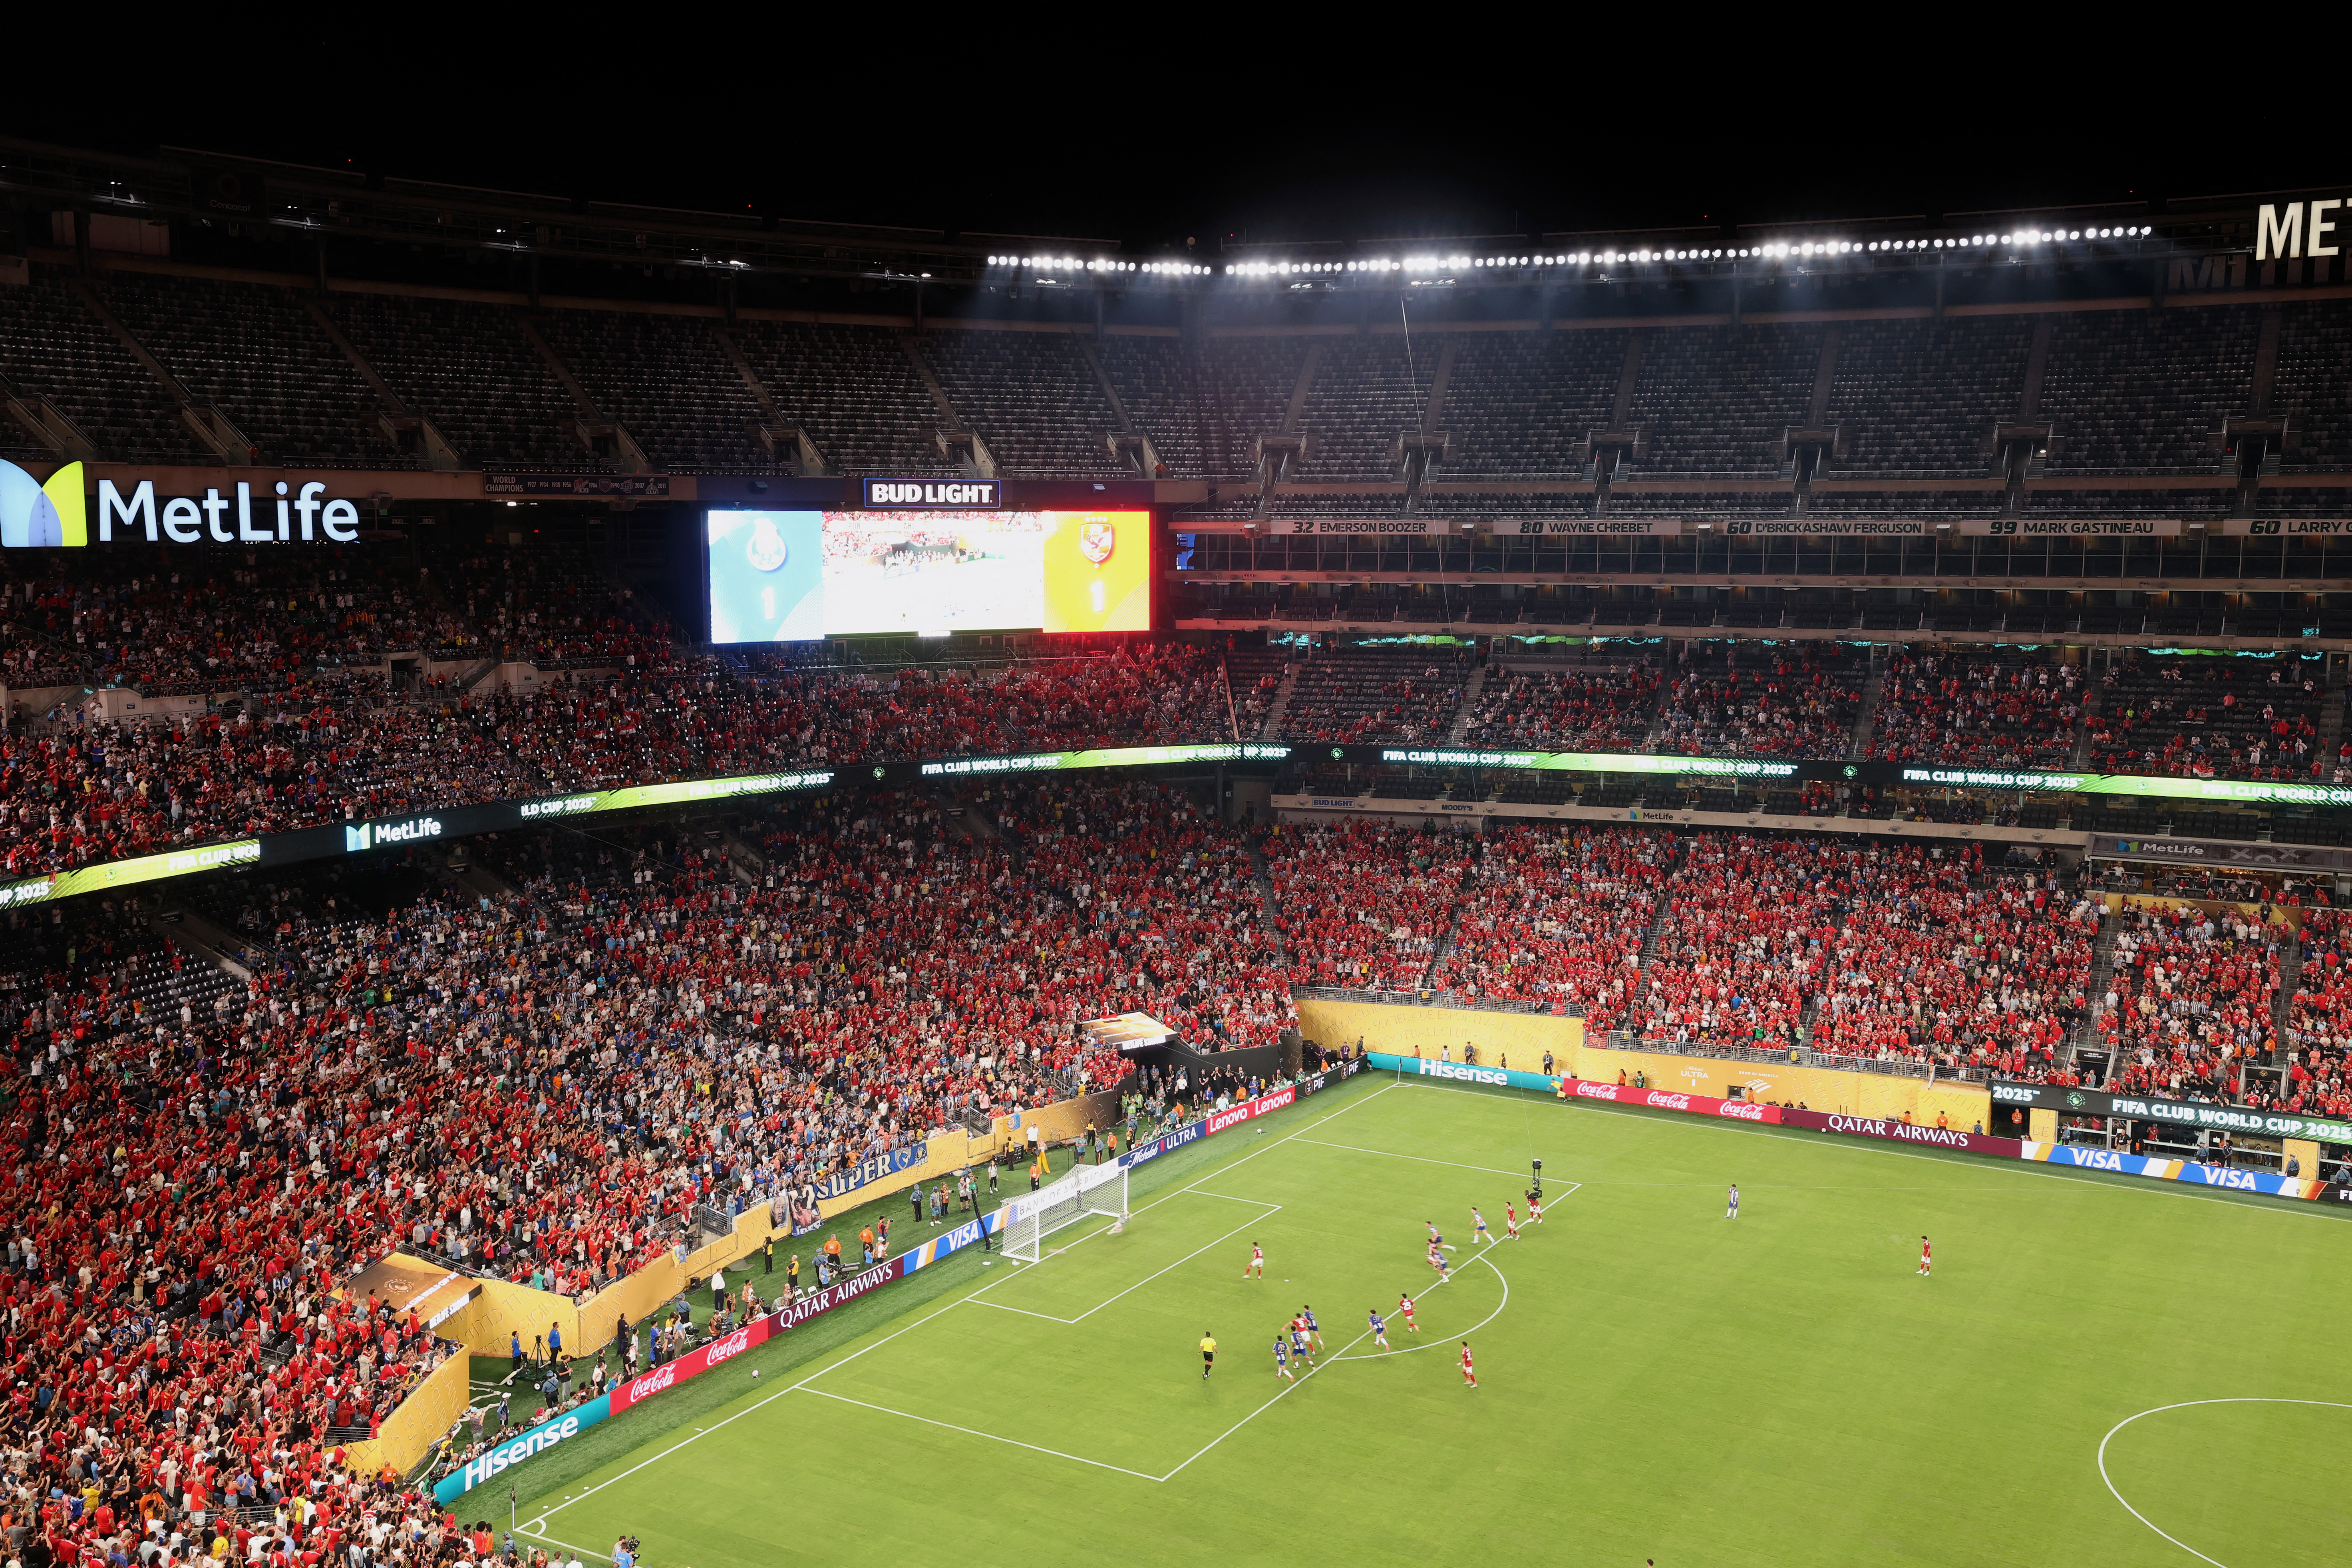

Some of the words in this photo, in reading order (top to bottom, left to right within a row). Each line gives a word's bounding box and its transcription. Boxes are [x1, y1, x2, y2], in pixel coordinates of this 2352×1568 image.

[2256, 198, 2352, 260] ME
[872, 484, 922, 503] BUD
[925, 485, 993, 503] LIGHT
[99, 480, 359, 543] MetLife
[1292, 522, 1314, 533] 32
[1320, 523, 1376, 533] EMERSON
[1378, 523, 1426, 533] BOOZER
[1520, 522, 1543, 534] 80
[1549, 523, 1594, 533] WAYNE
[1597, 523, 1652, 533] CHREBET
[1727, 522, 1752, 534] 60
[1756, 523, 1852, 533] D'BRICKASHAW
[1854, 523, 1921, 533] FERGUSON
[1990, 522, 2017, 534] 99
[2024, 523, 2067, 533] MARK
[2071, 523, 2153, 533] GASTINEAU
[2250, 521, 2281, 534] 60
[2288, 522, 2342, 533] LARRY
[760, 586, 774, 620] 1
[1090, 580, 1104, 612] 1
[1170, 749, 1196, 759] CLUB
[1197, 748, 1232, 758] WORLD
[1383, 751, 1406, 761] FIFA
[1408, 751, 1436, 762] CLUB
[1437, 752, 1478, 763] WORLD
[1479, 753, 1502, 764] CUP
[922, 764, 943, 775] FIFA
[944, 761, 970, 773] CLUB
[972, 759, 1009, 771] WORLD
[1010, 757, 1031, 768] CUP
[1634, 758, 1659, 769] FIFA
[1661, 759, 1691, 771] CLUB
[1693, 761, 1735, 773] WORLD
[1737, 763, 1760, 773] CUP
[689, 784, 712, 796] FIFA
[714, 782, 741, 794] CLUB
[742, 778, 779, 791] WORLD
[781, 776, 801, 788] CUP
[1903, 770, 1930, 781] FIFA
[1932, 771, 1965, 782] CLUB
[1967, 773, 2014, 785] WORLD
[2016, 775, 2042, 786] CUP
[2202, 783, 2232, 796] FIFA
[2235, 785, 2272, 798] CLUB
[2274, 787, 2331, 801] WORLD
[541, 801, 564, 813] CUP
[1642, 812, 1674, 821] MetLife
[375, 817, 441, 844] MetLife
[2143, 843, 2204, 854] MetLife
[169, 855, 198, 871] FIFA
[199, 849, 231, 865] CLUB
[1373, 1010, 1433, 1031] SOCIEDADE
[1438, 1010, 1495, 1028] ESPORTIVA
[1440, 1025, 1471, 1039] CLUB
[1348, 1061, 1359, 1074] PIF
[1420, 1059, 1508, 1085] Hisense
[1681, 1070, 1709, 1079] ULTRA
[1313, 1076, 1325, 1090] PIF
[1577, 1081, 1619, 1099] Coca-Cola
[1255, 1092, 1292, 1116] Lenovo
[1647, 1091, 1691, 1109] Coca-Cola
[1210, 1108, 1248, 1132] Lenovo
[1720, 1101, 1765, 1120] Coca-Cola
[2112, 1099, 2148, 1115] FIFA
[2151, 1104, 2195, 1121] CLUB
[2199, 1109, 2263, 1128] WORLD
[2266, 1118, 2302, 1133] CUP
[1828, 1115, 1887, 1135] QATAR
[1893, 1124, 1968, 1147] AIRWAYS
[1127, 1139, 1159, 1169] Michelob
[1166, 1127, 1198, 1149] ULTRA
[2068, 1147, 2121, 1171] VISA
[816, 1154, 892, 1198] SUPER
[2199, 1166, 2256, 1190] VISA
[1020, 1194, 1046, 1216] BANK
[1049, 1188, 1061, 1200] OF
[1064, 1169, 1104, 1193] AMERICA
[946, 1221, 979, 1251] VISA
[421, 1284, 441, 1297] WORLD
[437, 1278, 450, 1286] CUP
[779, 1292, 830, 1329] QATAR
[835, 1262, 893, 1302] AIRWAYS
[1402, 1301, 1412, 1310] 25
[707, 1328, 749, 1366] Coca-Cola
[630, 1362, 677, 1403] Coca-Cola
[465, 1416, 579, 1492] Hisense
